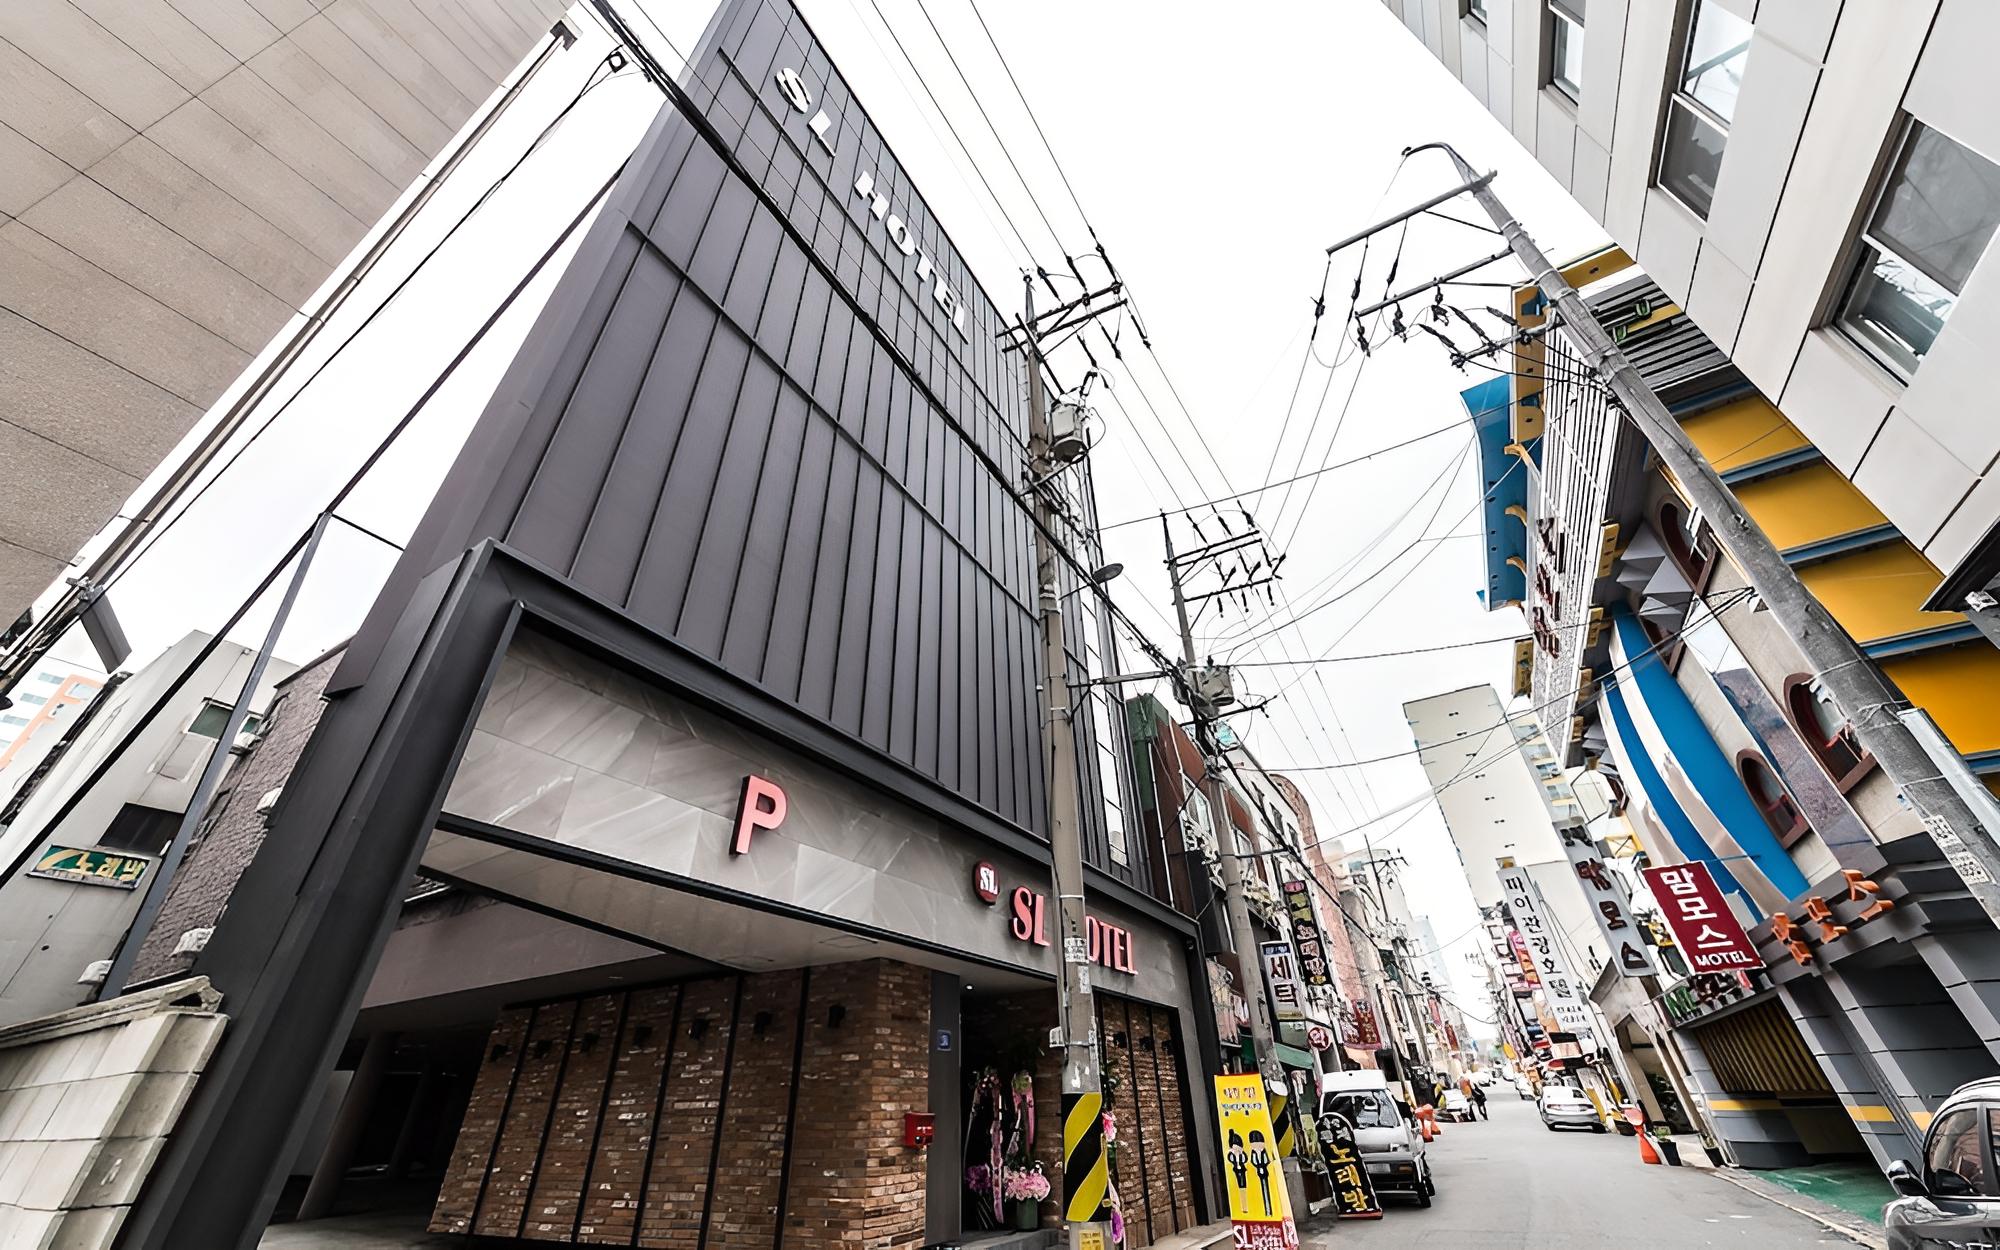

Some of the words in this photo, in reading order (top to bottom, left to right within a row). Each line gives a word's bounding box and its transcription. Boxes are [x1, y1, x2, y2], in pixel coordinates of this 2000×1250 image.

[775, 67, 836, 157] SL
[854, 170, 969, 345] HOTEL
[730, 775, 787, 856] P
[979, 866, 998, 895] SL
[1660, 868, 1734, 950] 맘모스
[1012, 886, 1050, 947] SL
[1085, 914, 1139, 976] OTEL
[1694, 950, 1754, 967] MOTEL
[1330, 1143, 1369, 1211] 노래방
